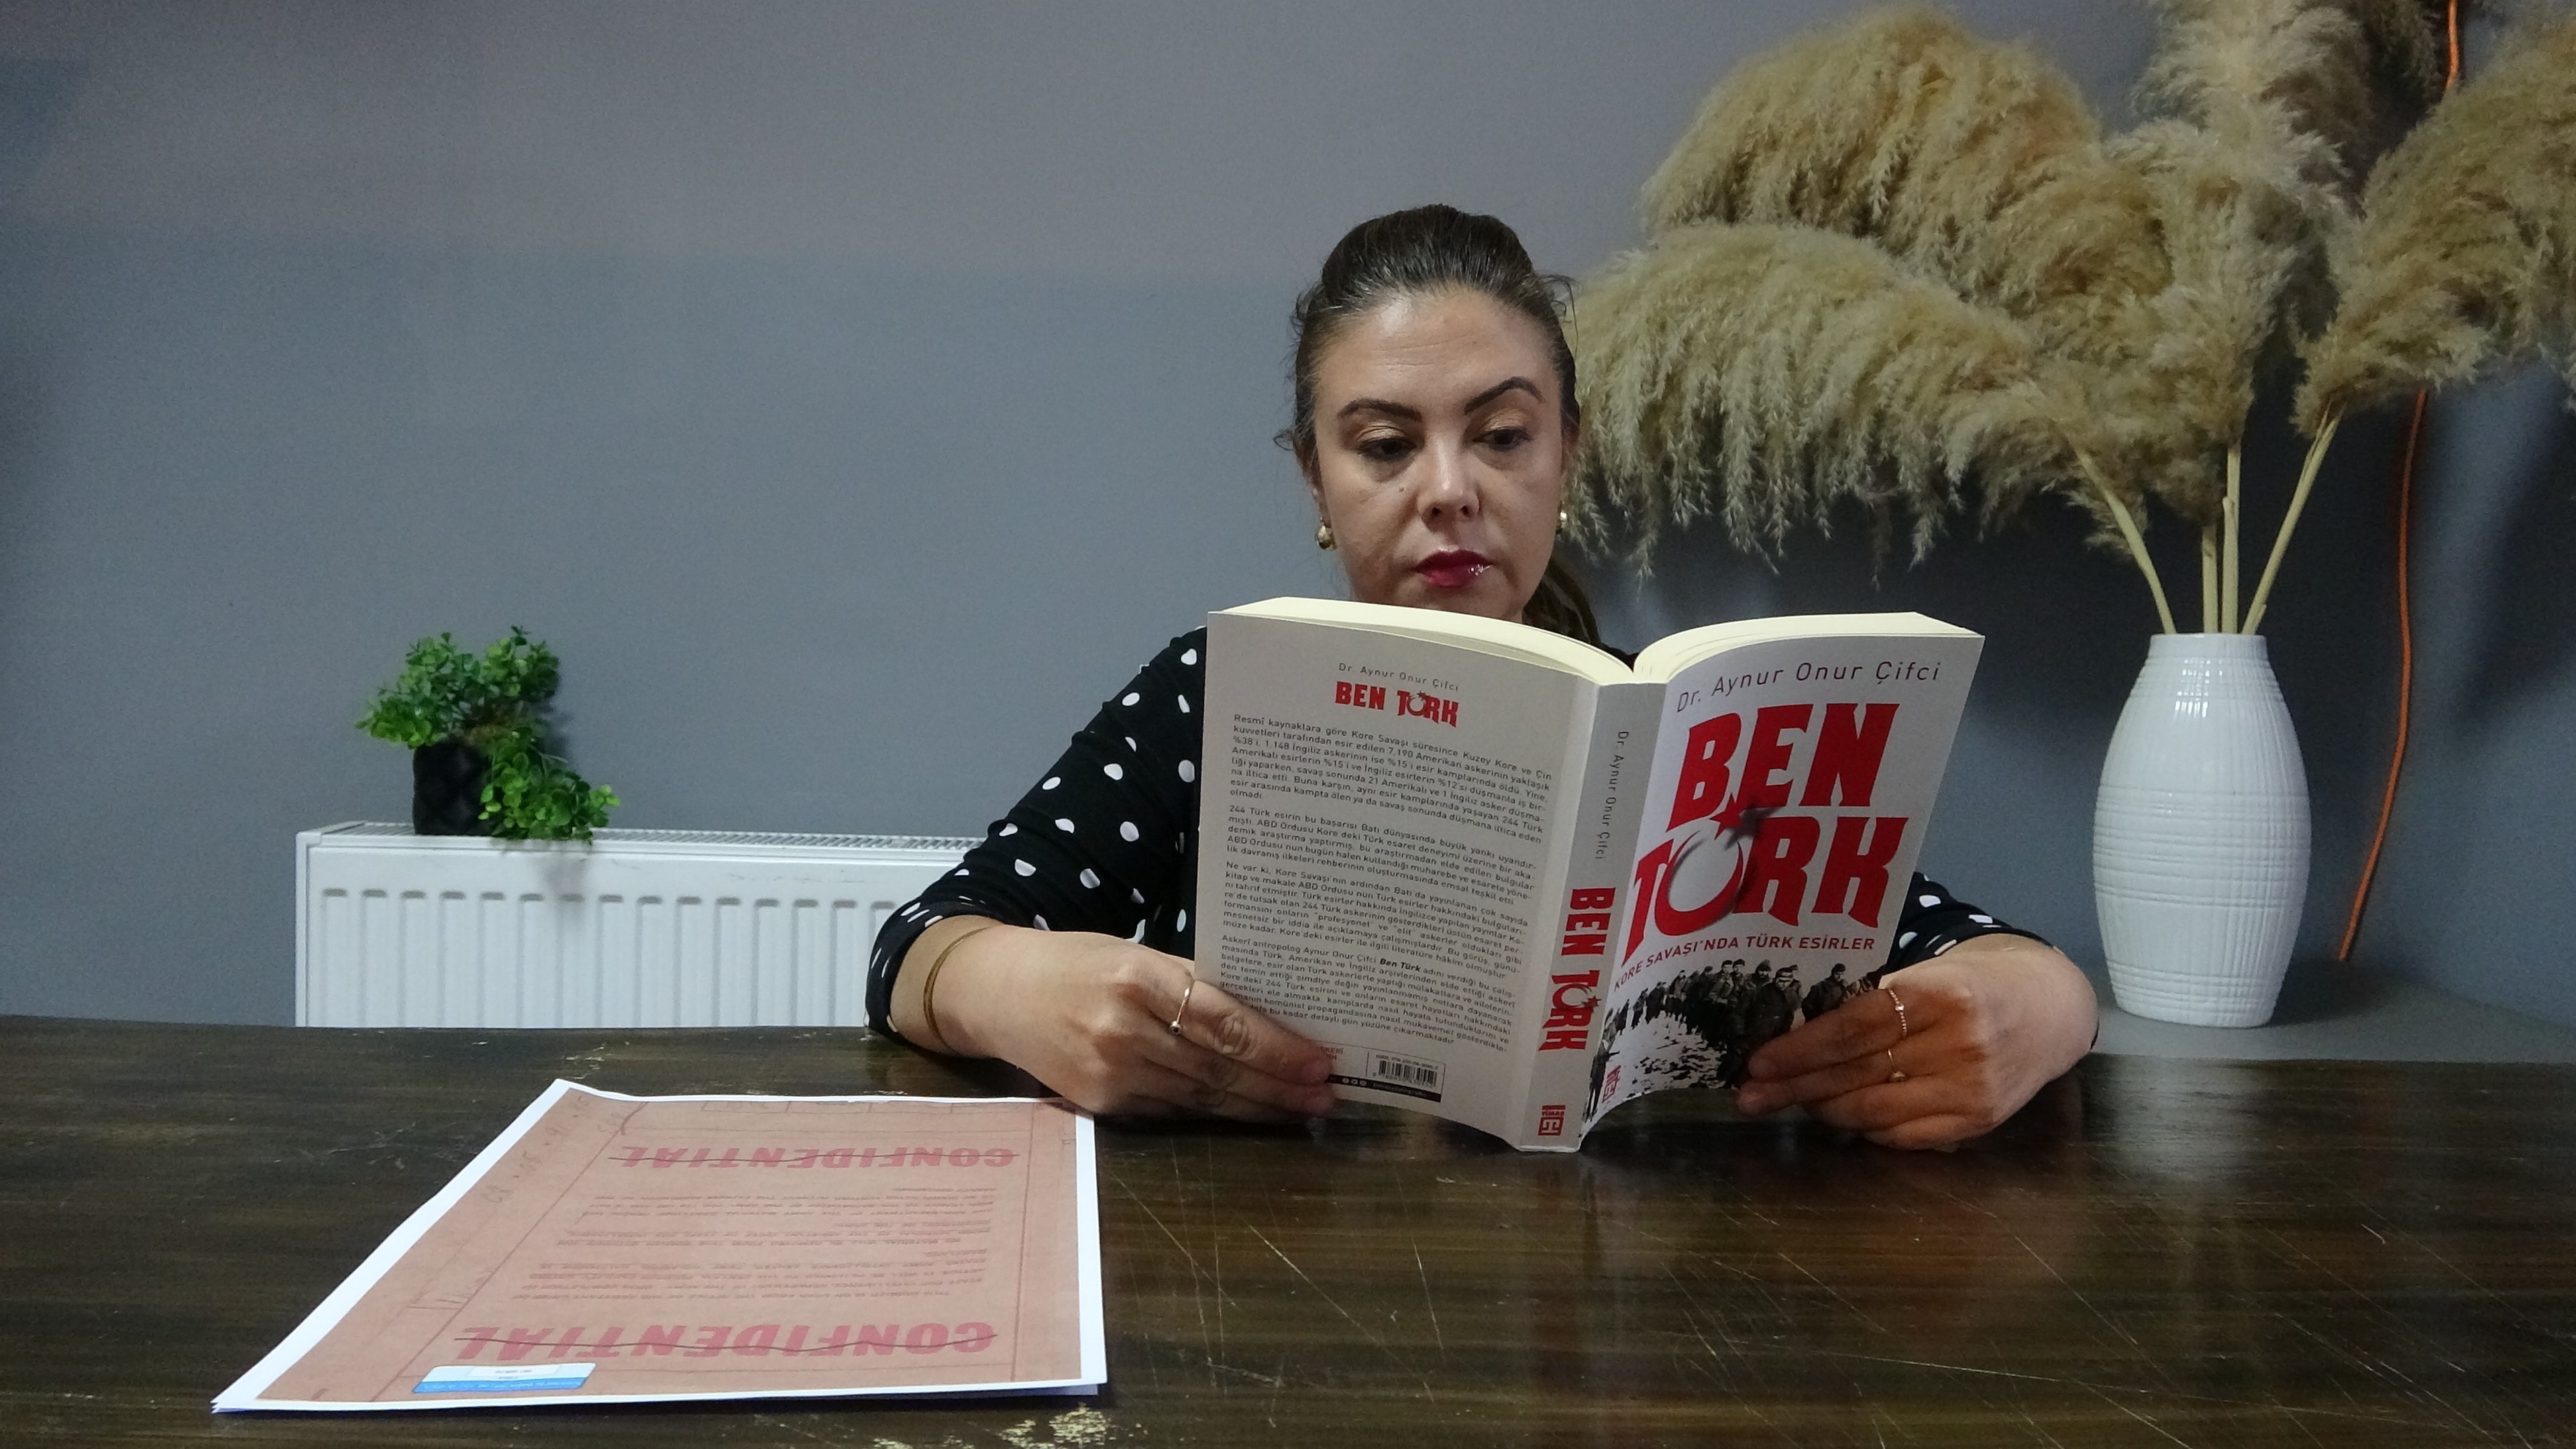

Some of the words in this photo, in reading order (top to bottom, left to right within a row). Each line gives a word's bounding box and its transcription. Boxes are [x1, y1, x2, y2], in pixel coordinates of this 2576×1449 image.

[1360, 666, 1395, 678] Aynur
[1399, 672, 1428, 684] Onur
[1432, 678, 1458, 692] Çifci
[1677, 691, 1701, 712] Dr.
[1711, 669, 1784, 697] Aynur
[1796, 662, 1863, 681] Onur
[1876, 661, 1941, 685] Çifci
[1335, 681, 1387, 710] BEN
[1609, 755, 1624, 791] Aynur
[1666, 703, 1900, 832] BEN
[1250, 807, 1269, 816] Türk
[1602, 796, 1617, 826] Onur
[1363, 834, 1383, 844] Türk
[1522, 821, 1542, 833] Türk
[1595, 832, 1610, 859] Çifci
[1561, 887, 1616, 955] BEN
[1614, 961, 1644, 991] KORE
[1646, 938, 1739, 967] SAVAŞI'NDA
[1746, 933, 1792, 949] TÜRK
[1799, 934, 1875, 951] ESİRLER
[622, 1146, 1014, 1169] CONFIDENTIAL
[454, 1322, 996, 1360] CONFIDENTIAL
